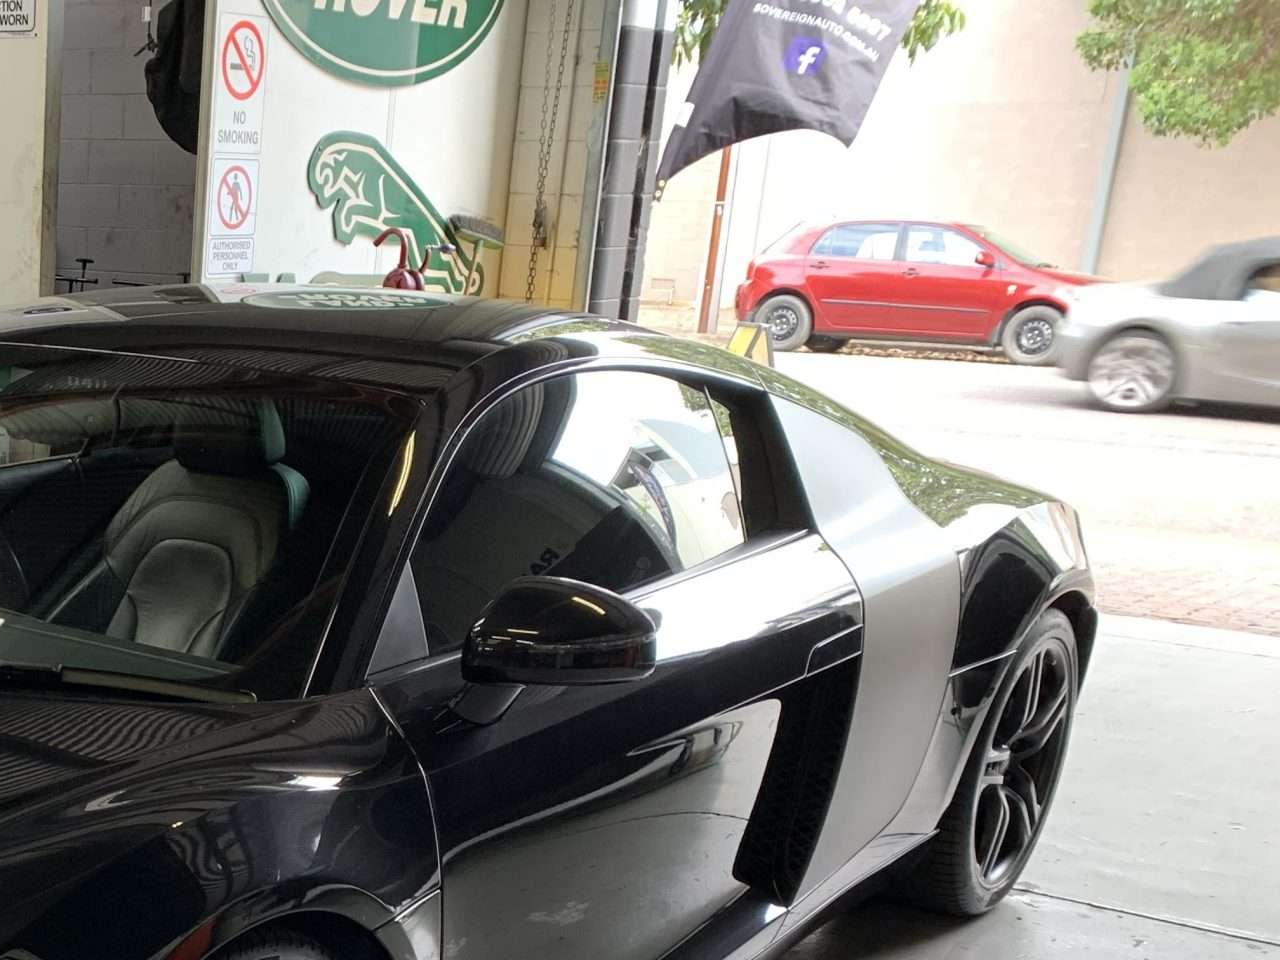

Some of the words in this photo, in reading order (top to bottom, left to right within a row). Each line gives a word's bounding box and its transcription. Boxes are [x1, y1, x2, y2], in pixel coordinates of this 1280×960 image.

[0, 13, 29, 25] WORN
[233, 110, 246, 125] NO
[217, 129, 259, 145] SMOKING
[213, 250, 249, 260] PERSONNEL
[222, 261, 238, 271] ONLY
